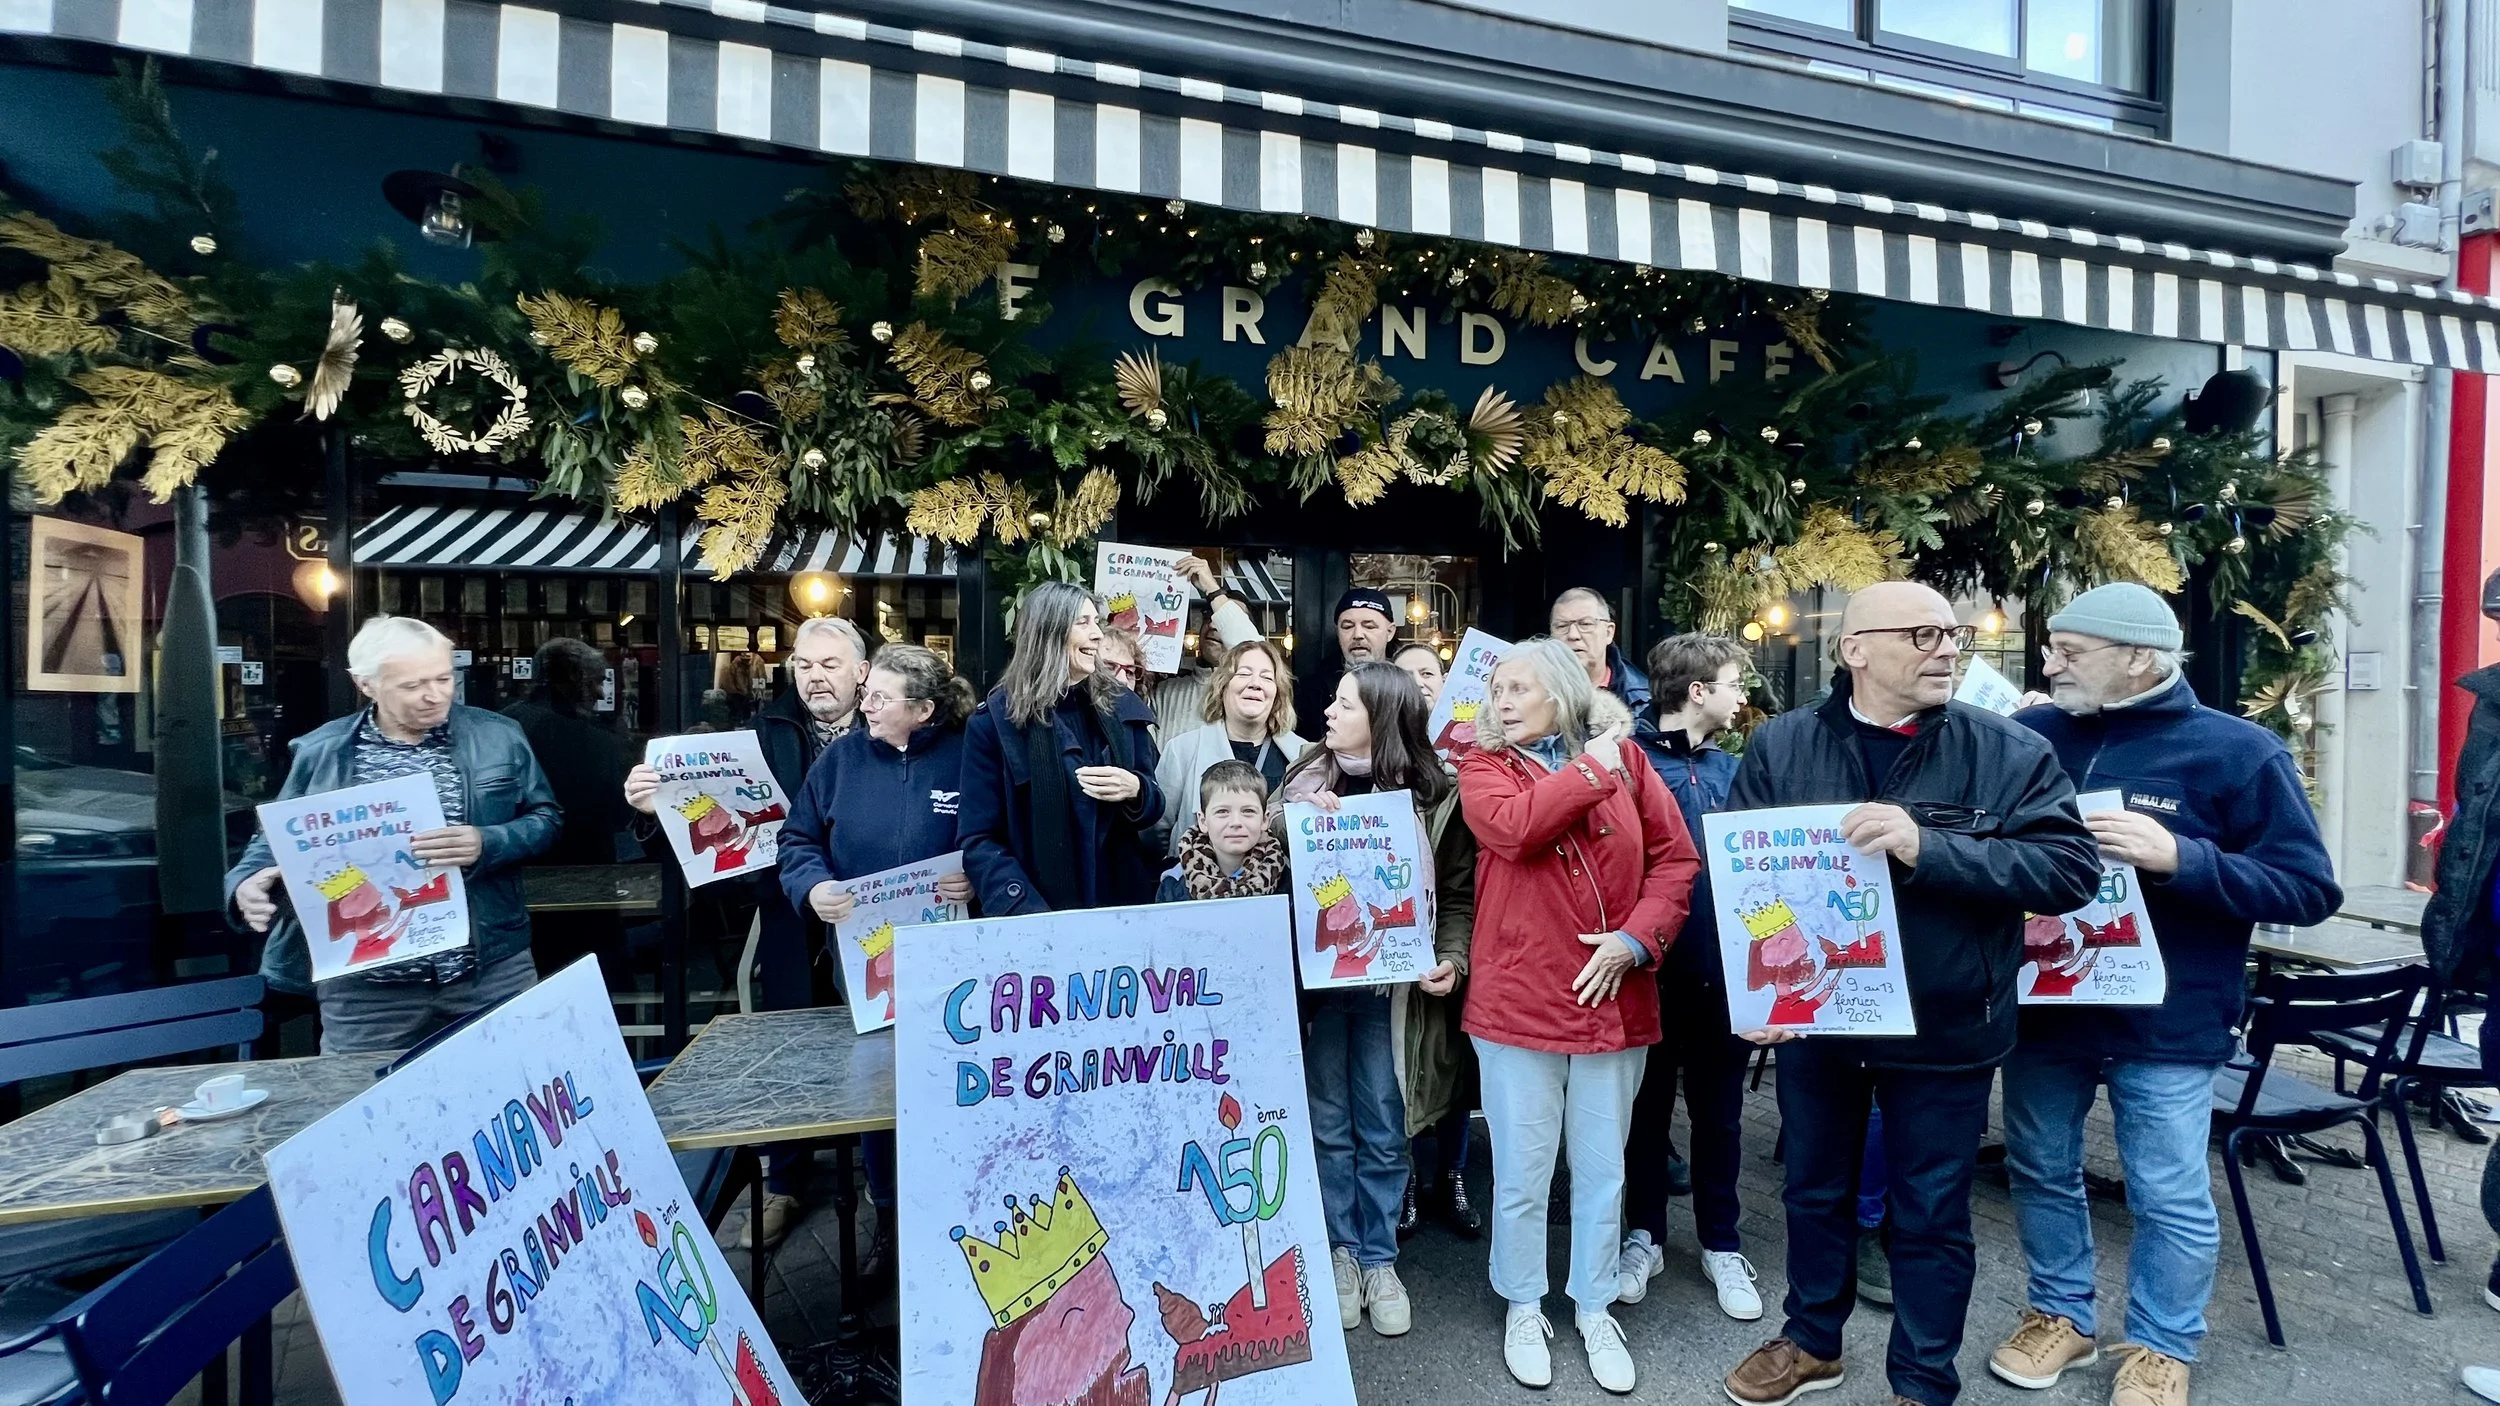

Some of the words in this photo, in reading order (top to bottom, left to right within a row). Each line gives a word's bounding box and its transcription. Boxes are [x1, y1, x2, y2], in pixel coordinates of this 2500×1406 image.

[1129, 277, 1507, 366] GRAND
[1107, 553, 1174, 568] CARNAVAL
[1109, 567, 1121, 575] DE
[1155, 591, 1183, 611] 150
[1465, 664, 1481, 678] DE
[654, 751, 739, 772] CARNAVAL
[660, 773, 678, 783] DE
[735, 783, 773, 801] 150
[286, 800, 407, 837] CARNAVAL
[1301, 815, 1389, 835] CARNAVAL
[297, 837, 321, 852] DE
[1307, 839, 1324, 852] DE
[1724, 828, 1846, 853] CARNAVAL
[1731, 857, 1755, 872] DE
[846, 869, 938, 894] CARNAVAL
[1374, 862, 1412, 891] 150
[2096, 873, 2127, 903] 50
[1826, 888, 1880, 921] 150
[1388, 935, 1397, 947] 9
[1412, 937, 1422, 947] 13
[1389, 960, 1415, 972] 2024
[2104, 956, 2116, 969] 9
[2136, 960, 2150, 971] 13
[1846, 977, 1859, 991] 9
[1880, 983, 1895, 994] 13
[2092, 970, 2136, 989] février
[2102, 984, 2135, 996] 2024
[943, 966, 1223, 1044] CARNAVAL
[1833, 994, 1880, 1015] février
[1847, 1008, 1882, 1022] 2024
[956, 1057, 1014, 1106] DE
[1177, 1125, 1287, 1227] 150
[367, 1070, 595, 1313] CARNAVAL
[635, 1220, 717, 1355] 150
[415, 1294, 486, 1406] DE
